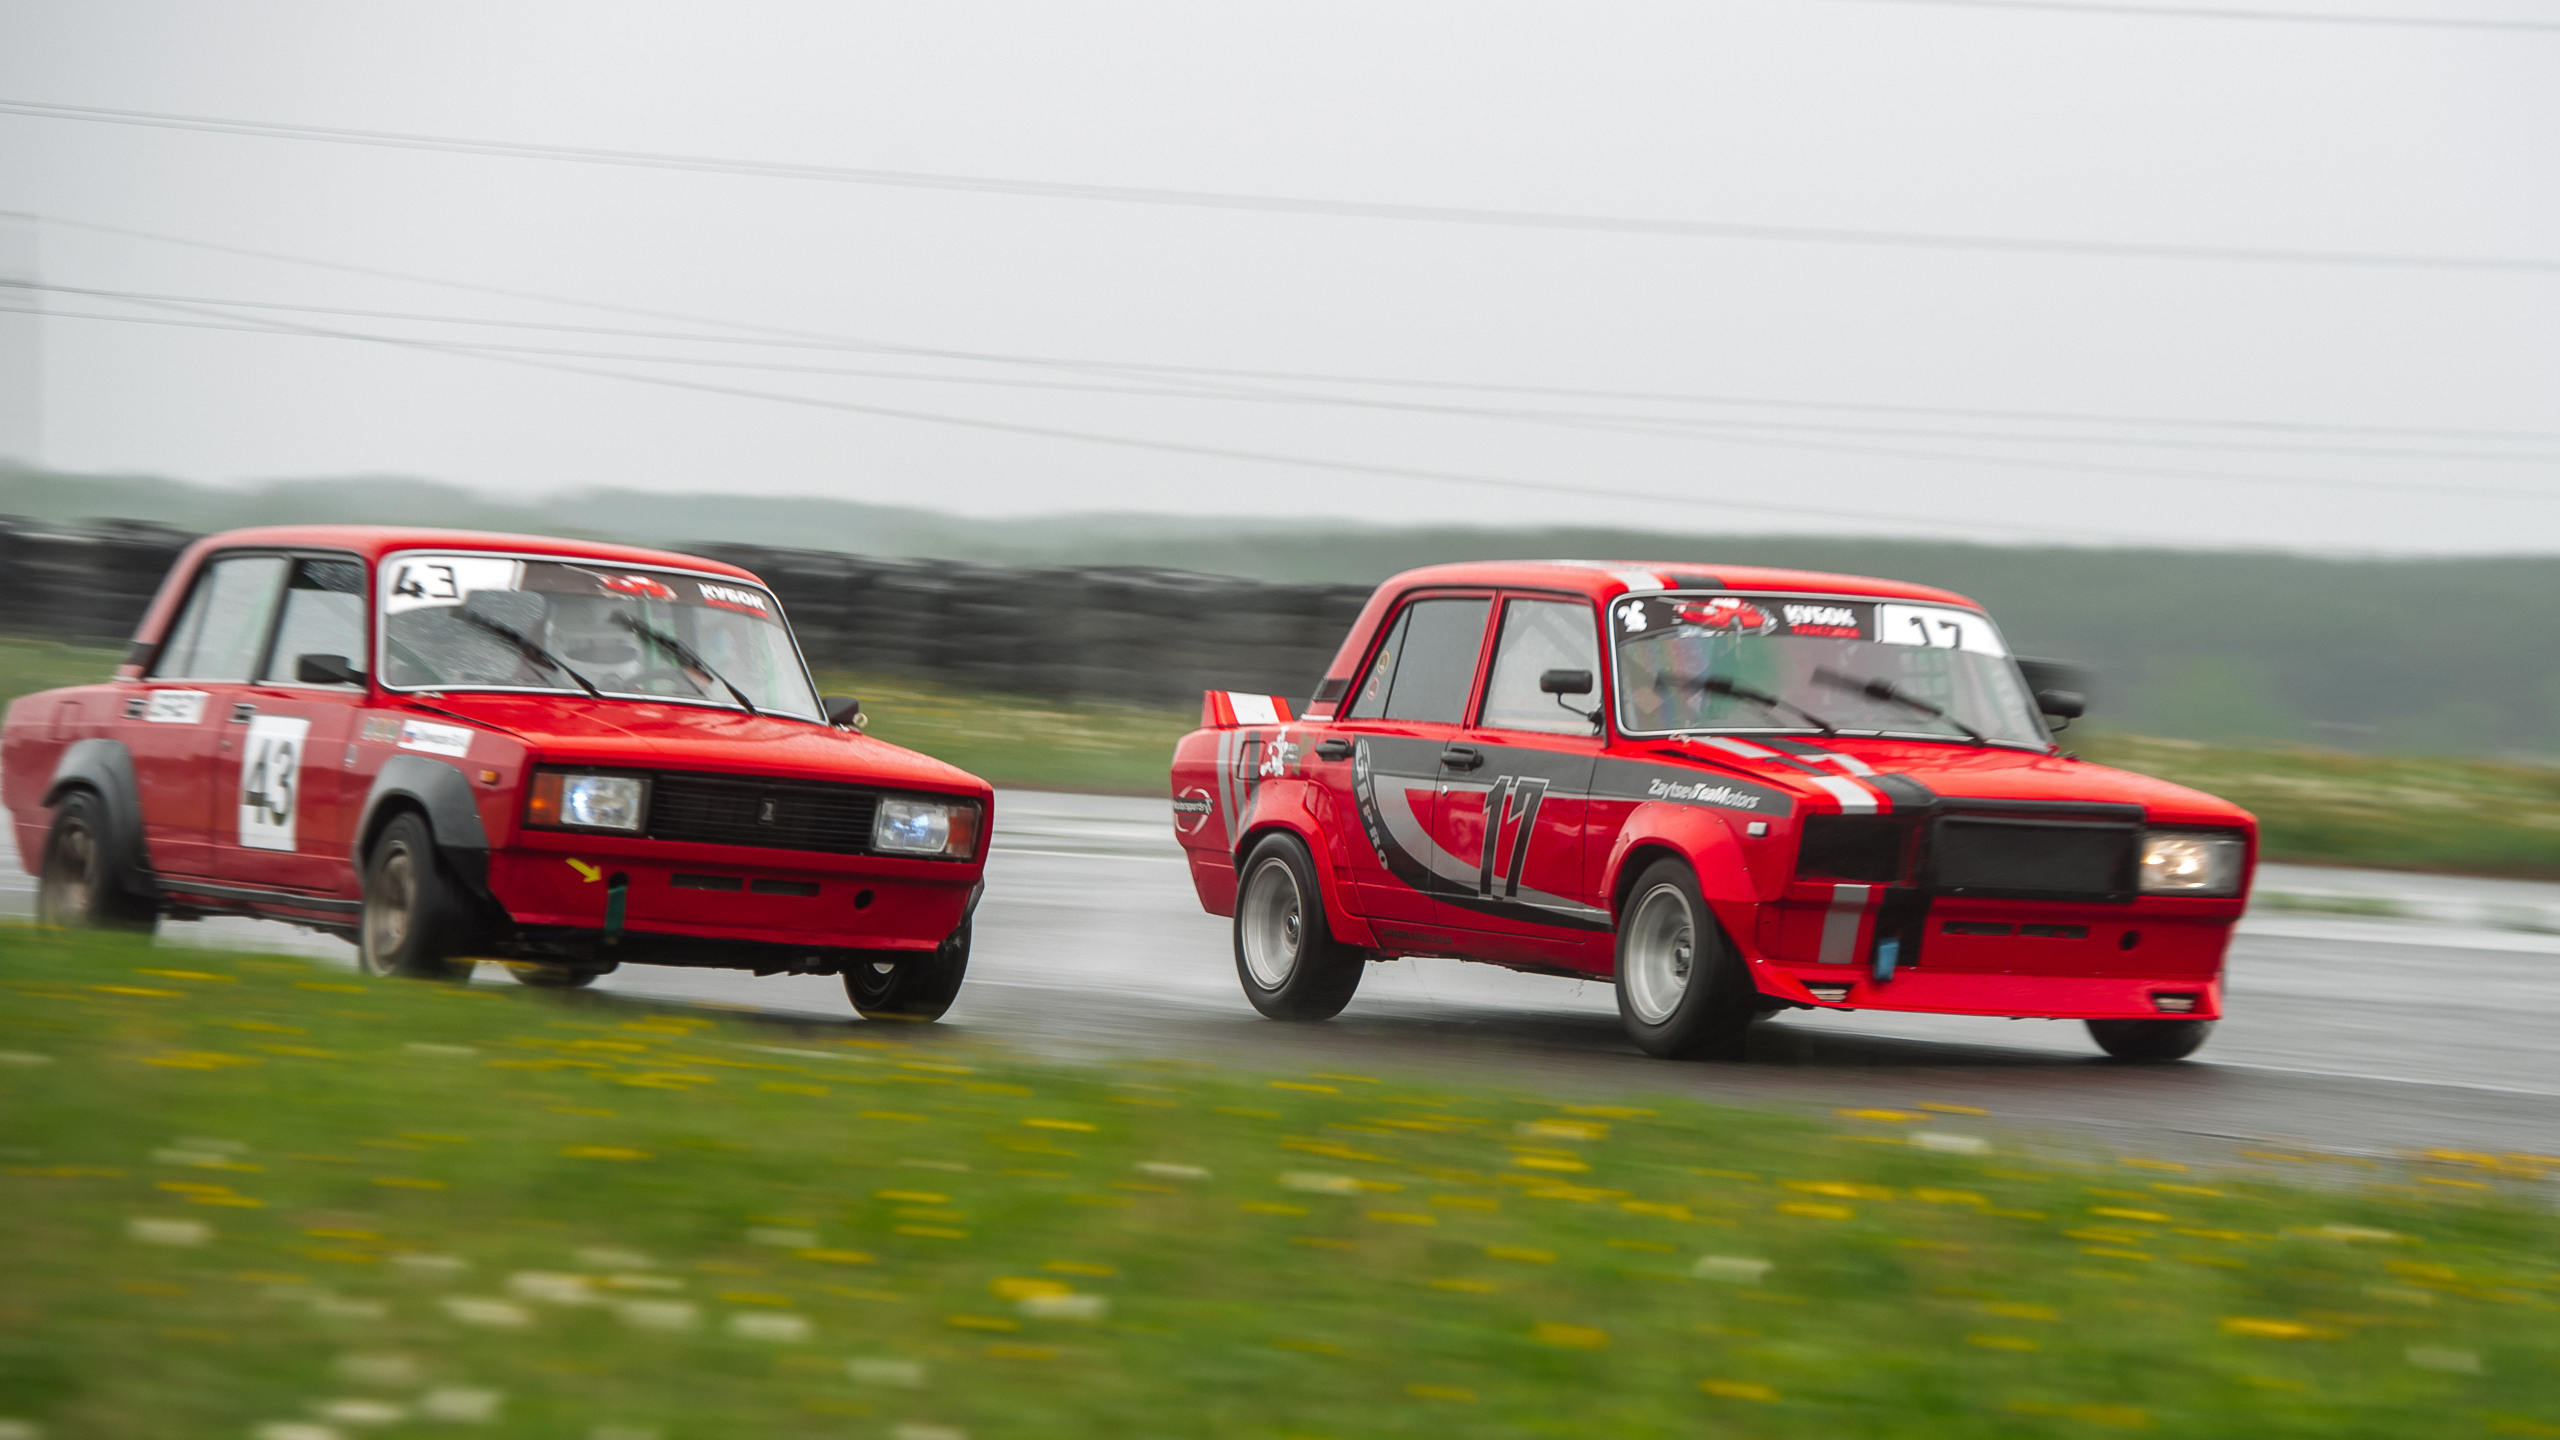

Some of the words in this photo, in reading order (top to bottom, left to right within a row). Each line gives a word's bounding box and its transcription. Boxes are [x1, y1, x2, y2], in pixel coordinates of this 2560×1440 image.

[392, 565, 459, 599] 43
[697, 583, 767, 611] КУБОК
[1782, 604, 1857, 627] КУБОК
[1909, 616, 1962, 650] 17
[246, 738, 294, 827] 43
[1478, 775, 1550, 900] 17
